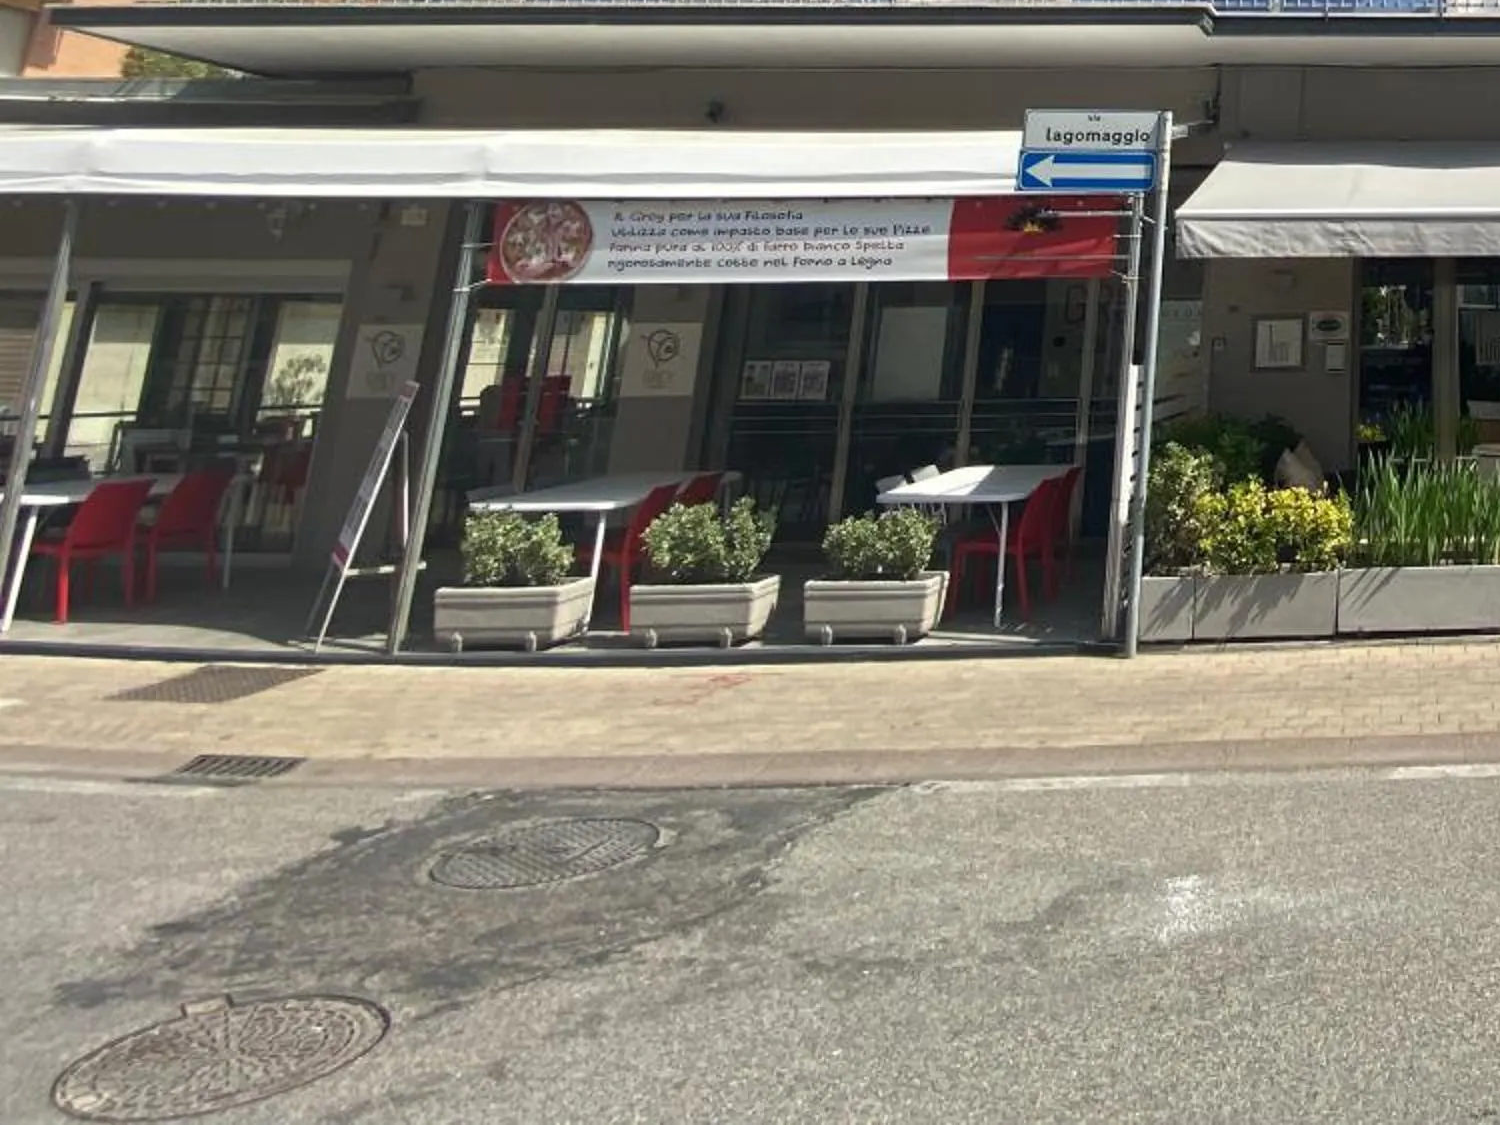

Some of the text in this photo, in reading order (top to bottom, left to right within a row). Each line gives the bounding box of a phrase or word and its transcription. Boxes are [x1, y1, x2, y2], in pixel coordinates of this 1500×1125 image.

[670, 212, 693, 223] per
[715, 212, 741, 220] sua
[671, 228, 709, 236] come
[713, 226, 771, 238] impasto
[776, 226, 809, 236] base
[814, 227, 839, 238] per
[863, 227, 889, 236] sue
[656, 243, 687, 254] pura
[711, 241, 743, 253] 100%
[747, 242, 758, 252] di
[608, 259, 712, 271] rigorosamente
[717, 258, 759, 267] cotte
[763, 257, 788, 267] nel
[837, 258, 846, 266] a
